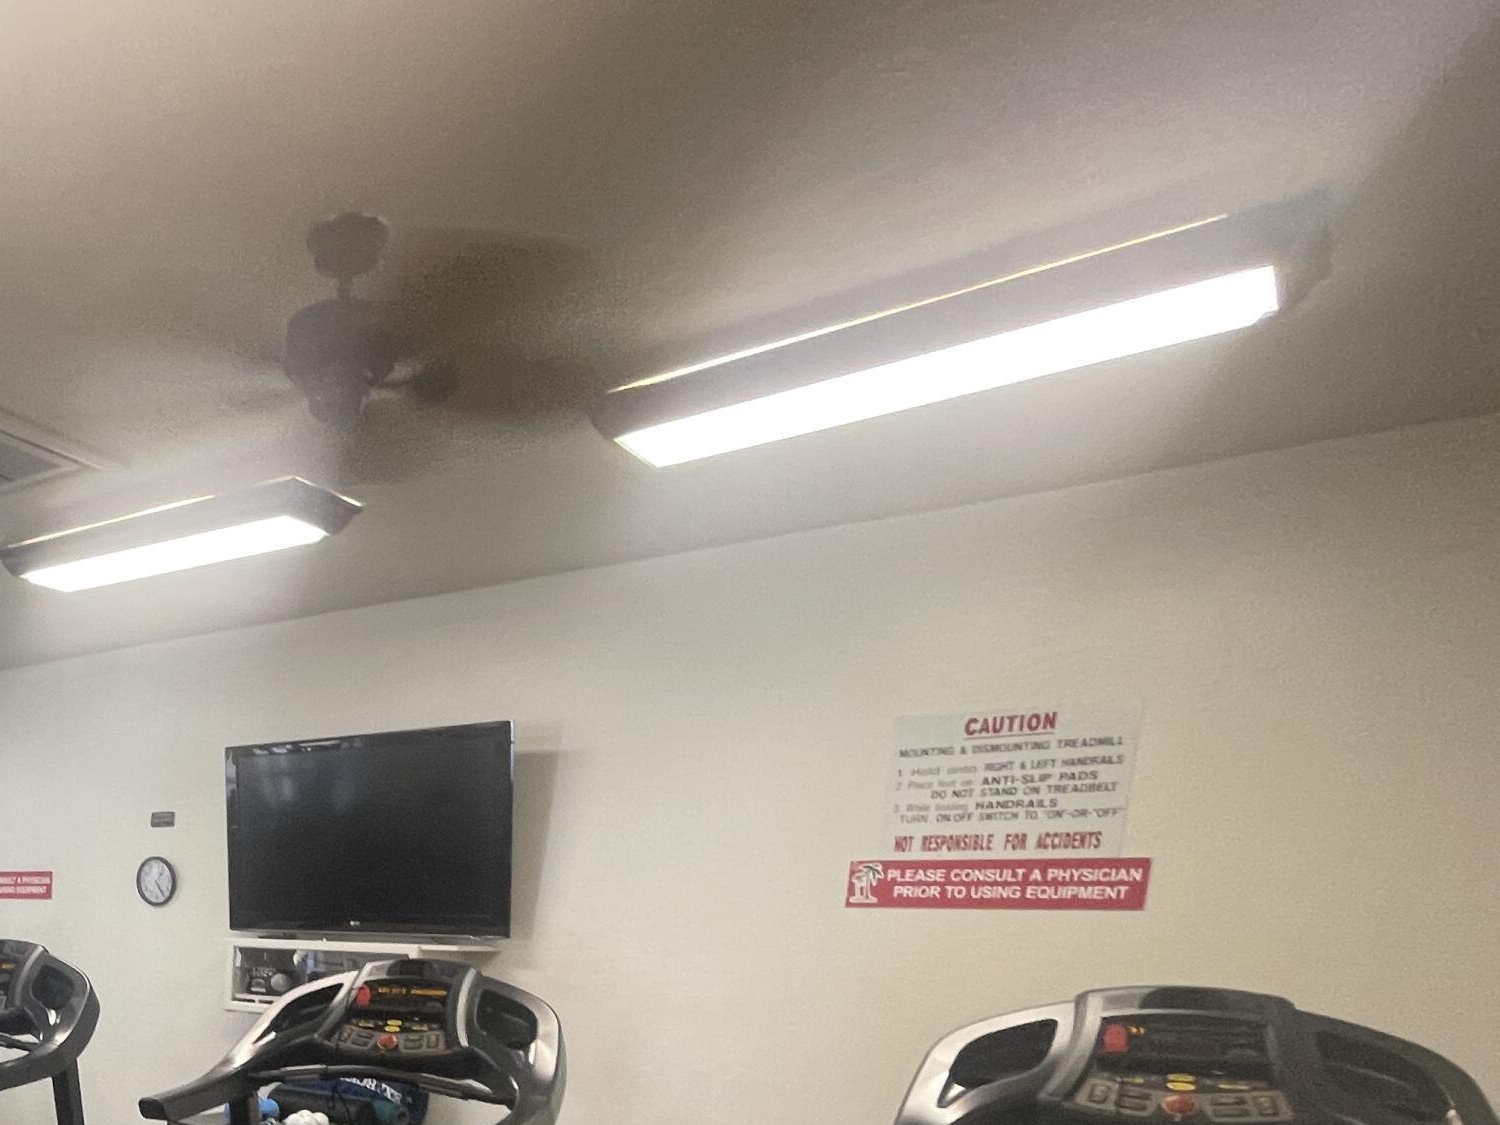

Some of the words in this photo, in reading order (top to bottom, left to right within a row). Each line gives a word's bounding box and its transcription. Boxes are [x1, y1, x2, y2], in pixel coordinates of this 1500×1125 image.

[964, 712, 1057, 735] CAUTION
[899, 746, 954, 757] MOUNTING
[971, 741, 1051, 753] DISMOUNTING
[1058, 736, 1123, 749] TREADMILL
[984, 761, 1015, 771] RIGHT
[1031, 759, 1056, 769] LEFT
[1061, 754, 1124, 767] HANDRAILS
[982, 773, 1052, 785] ANTI-SLIP
[1059, 771, 1098, 781] PADS
[930, 790, 947, 799] DO
[952, 788, 974, 798] NOT
[980, 786, 1017, 797] STAND
[1023, 786, 1040, 795] ON
[1047, 782, 1118, 794] TREADBELT
[975, 798, 1058, 810] HANDRAILS
[900, 814, 929, 823] TURN
[980, 811, 1019, 821] SWITCH
[1025, 810, 1038, 820] TO
[894, 835, 914, 852] NOT
[921, 834, 993, 852] RESPONSIBLE
[1004, 833, 1027, 850] FOR
[1035, 831, 1102, 849] ACCIDENTS
[887, 869, 946, 882] PLEASE
[950, 868, 1025, 882] CONSULT
[1029, 868, 1042, 881] A
[1047, 868, 1143, 882] PHYSICIAN
[893, 886, 941, 898] PRIOR
[945, 886, 966, 898] TO
[970, 886, 1021, 899] USING
[1025, 886, 1130, 899] EQUIPMENT
